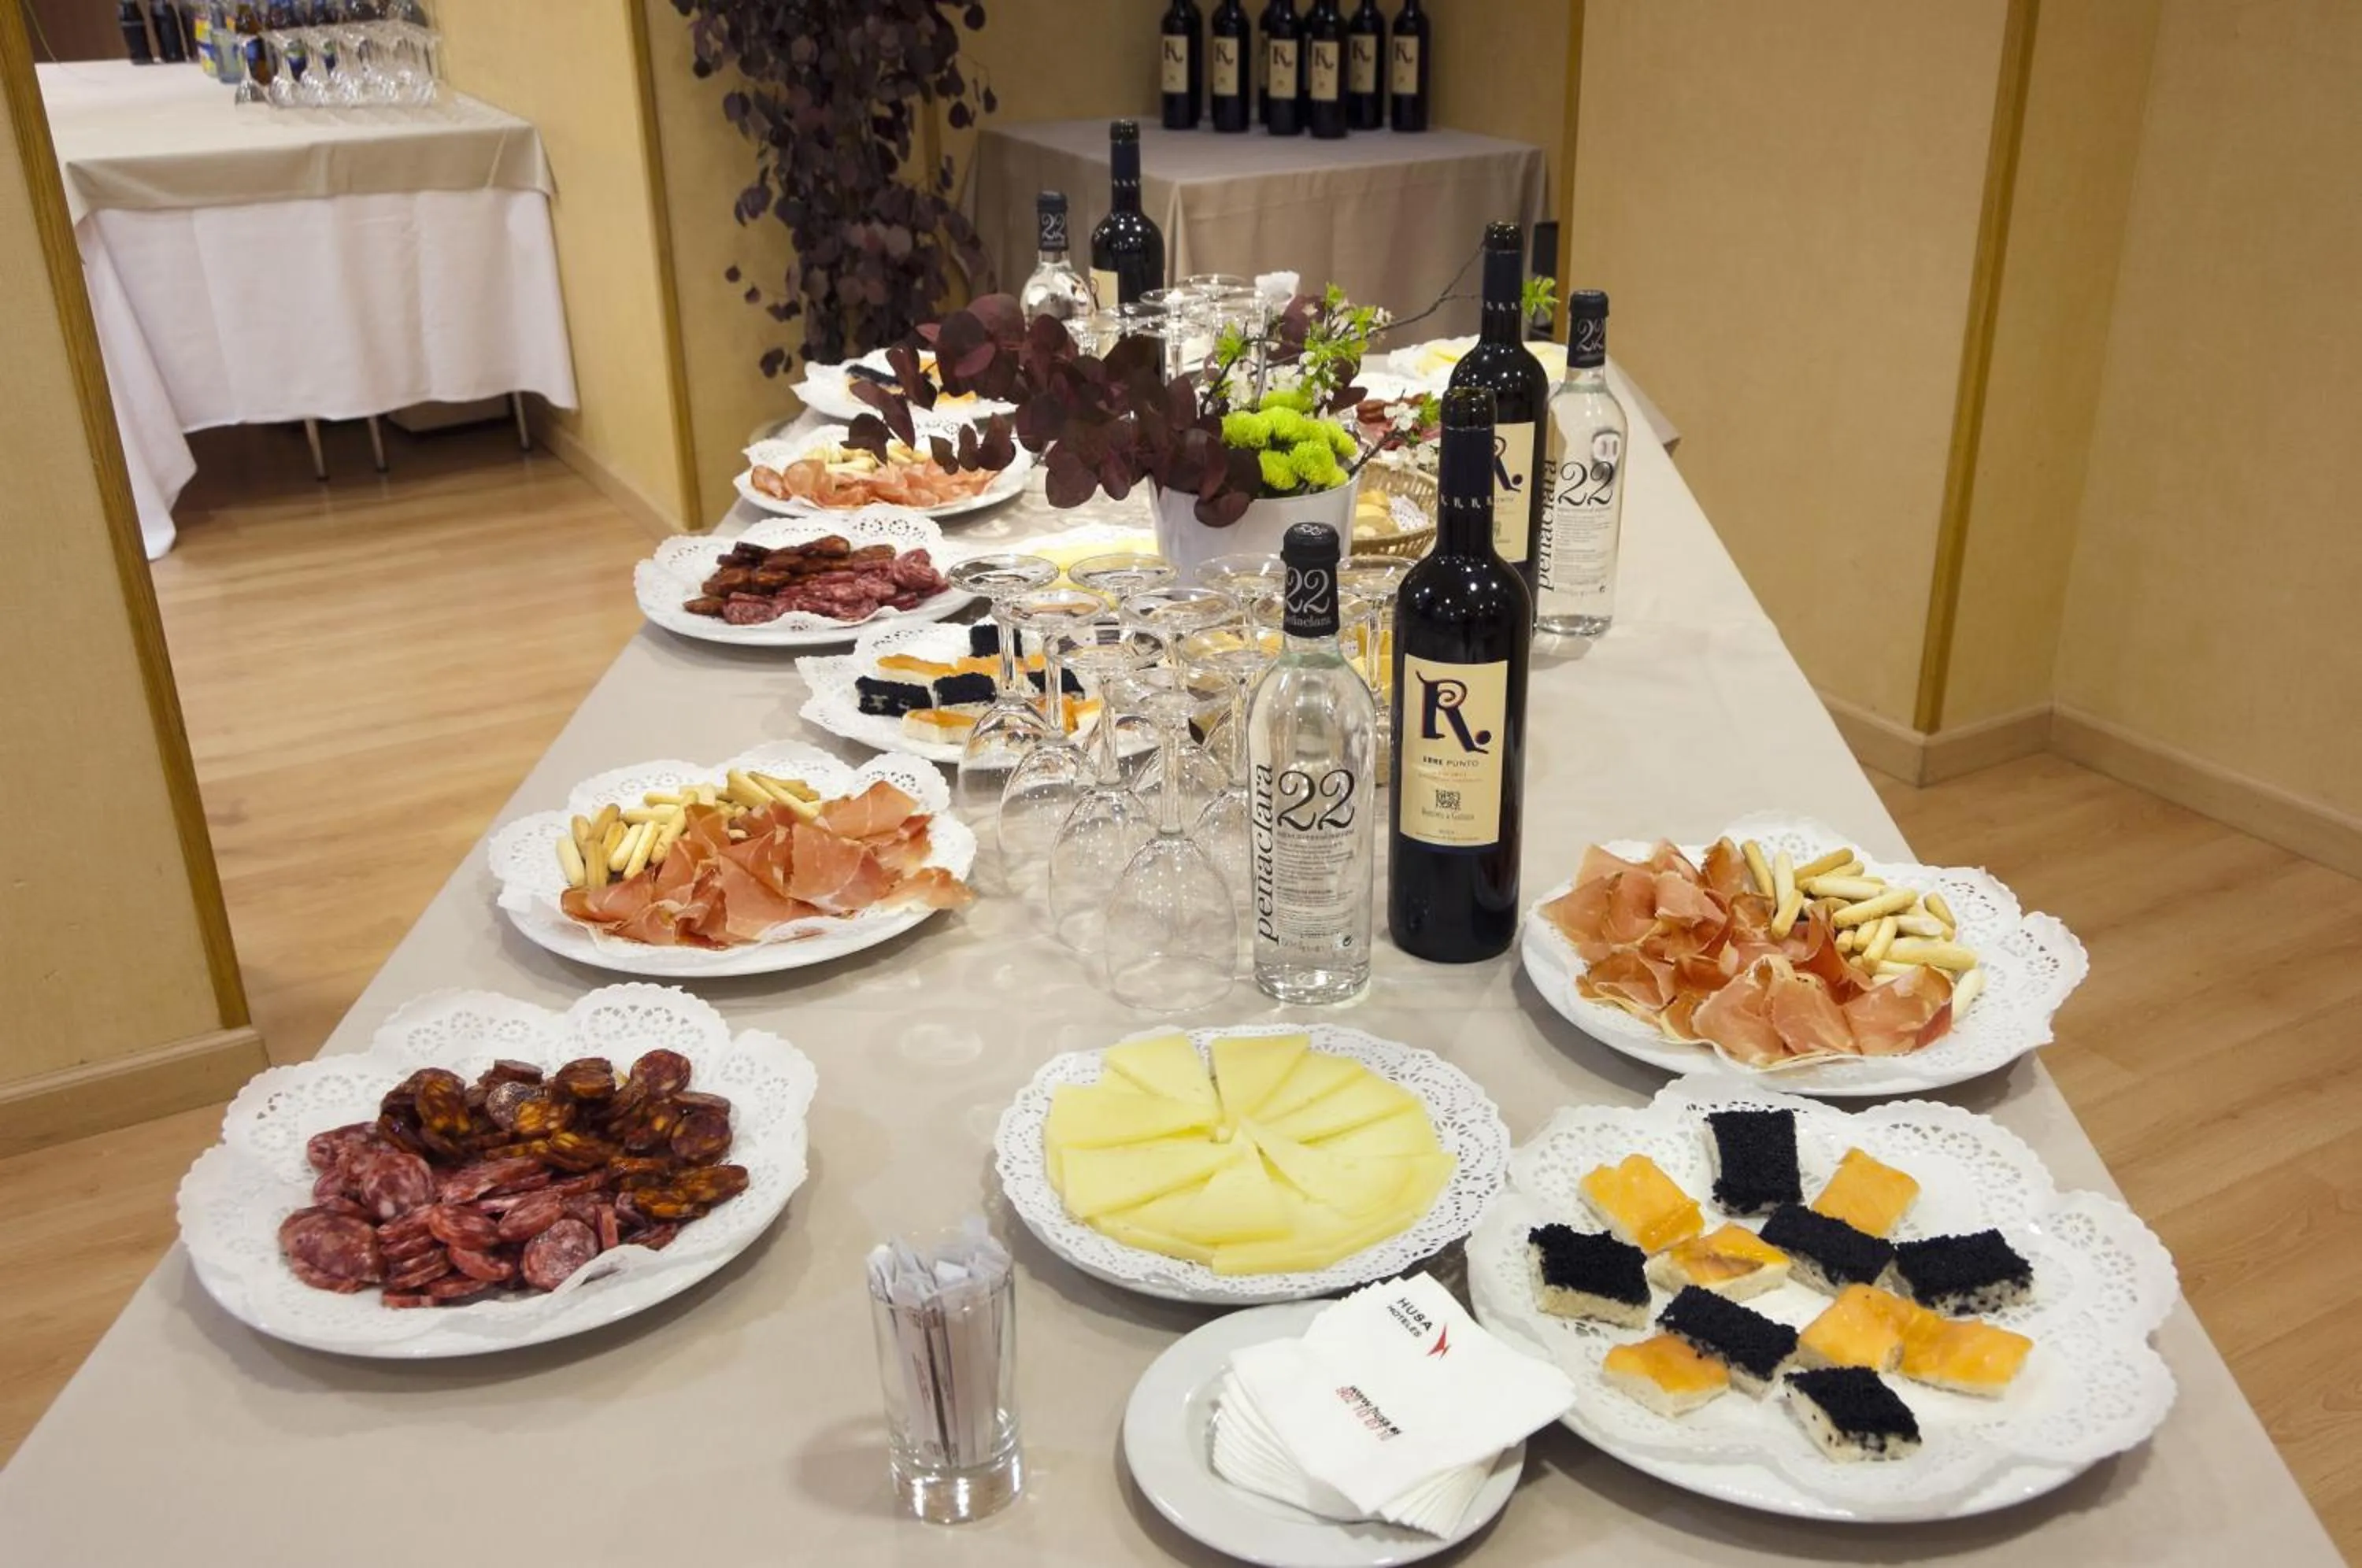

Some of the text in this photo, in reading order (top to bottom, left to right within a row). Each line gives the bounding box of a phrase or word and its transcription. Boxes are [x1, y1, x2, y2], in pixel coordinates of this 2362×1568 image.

[1042, 213, 1065, 239] 22
[1577, 318, 1605, 352] 22
[1558, 460, 1614, 506] 22
[1286, 566, 1331, 615] 22
[1415, 670, 1491, 754] R.
[1446, 759, 1479, 768] PUNTO
[1276, 769, 1355, 832] 22
[1386, 1304, 1422, 1338] HOTELES
[1397, 1297, 1433, 1331] HUSA
